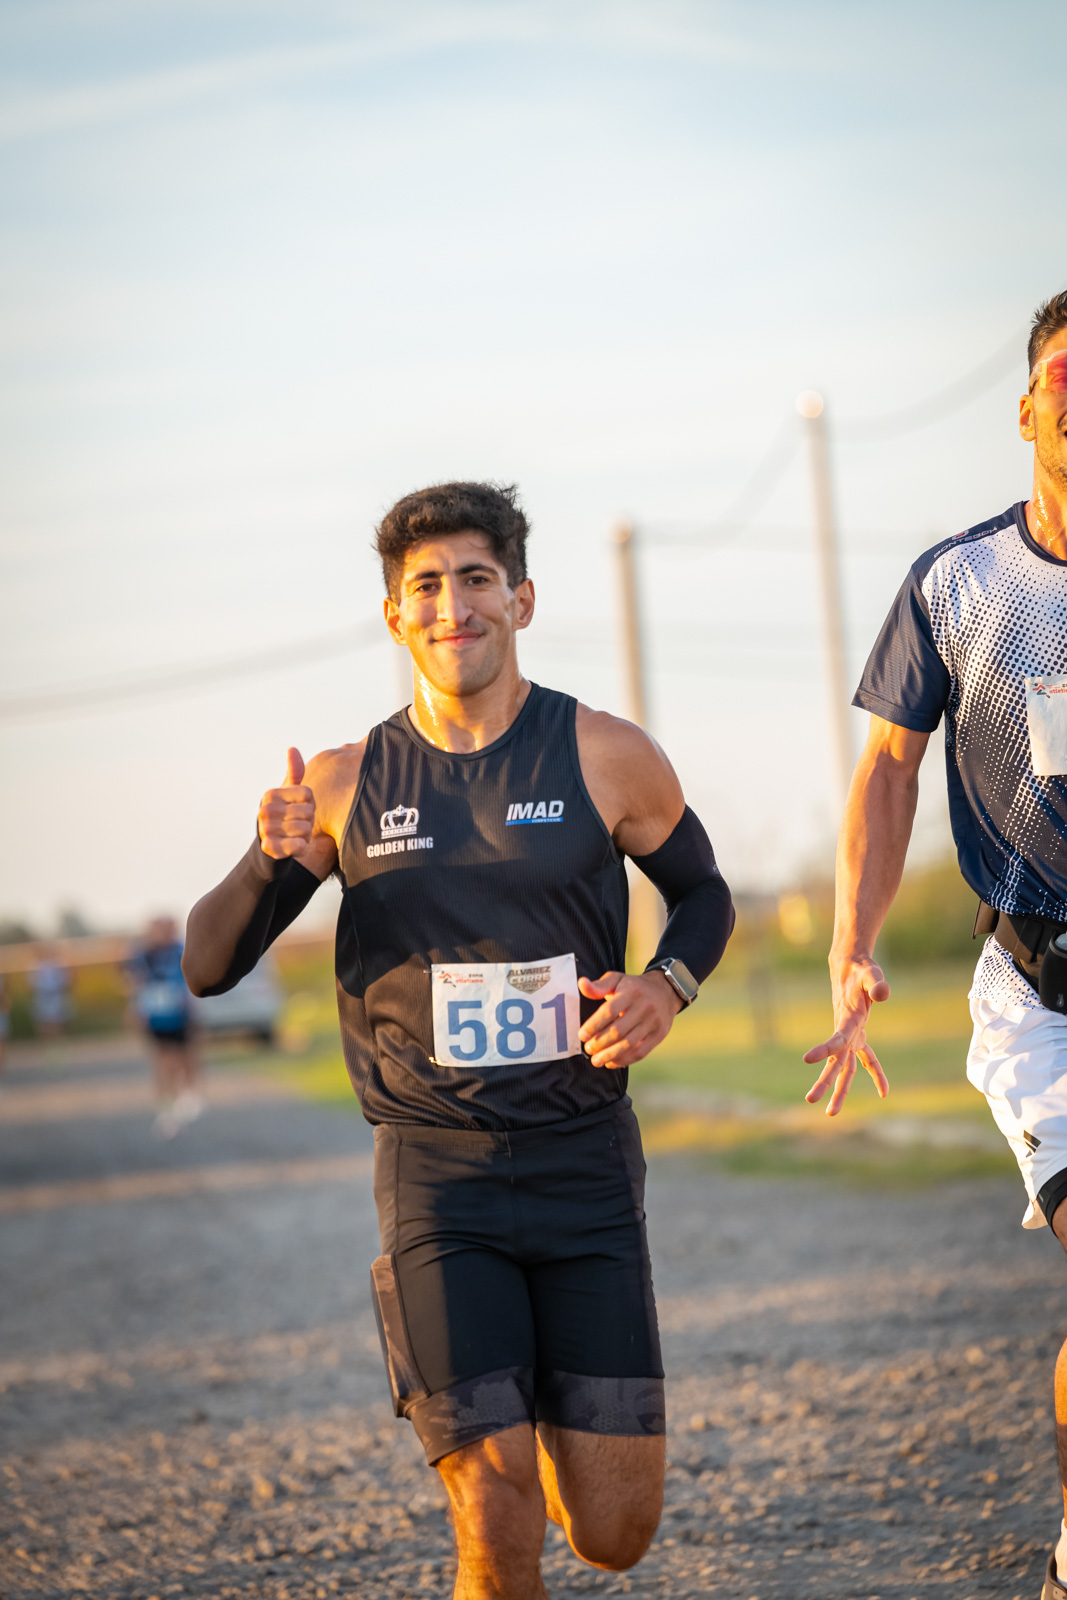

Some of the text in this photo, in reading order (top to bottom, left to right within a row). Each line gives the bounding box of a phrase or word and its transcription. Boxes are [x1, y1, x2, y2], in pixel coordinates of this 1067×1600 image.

[506, 800, 564, 821] IMAD
[366, 836, 434, 858] GOLDEN KING
[507, 965, 552, 977] ALVAREZ
[509, 973, 551, 985] CORRE
[447, 993, 569, 1061] 581
